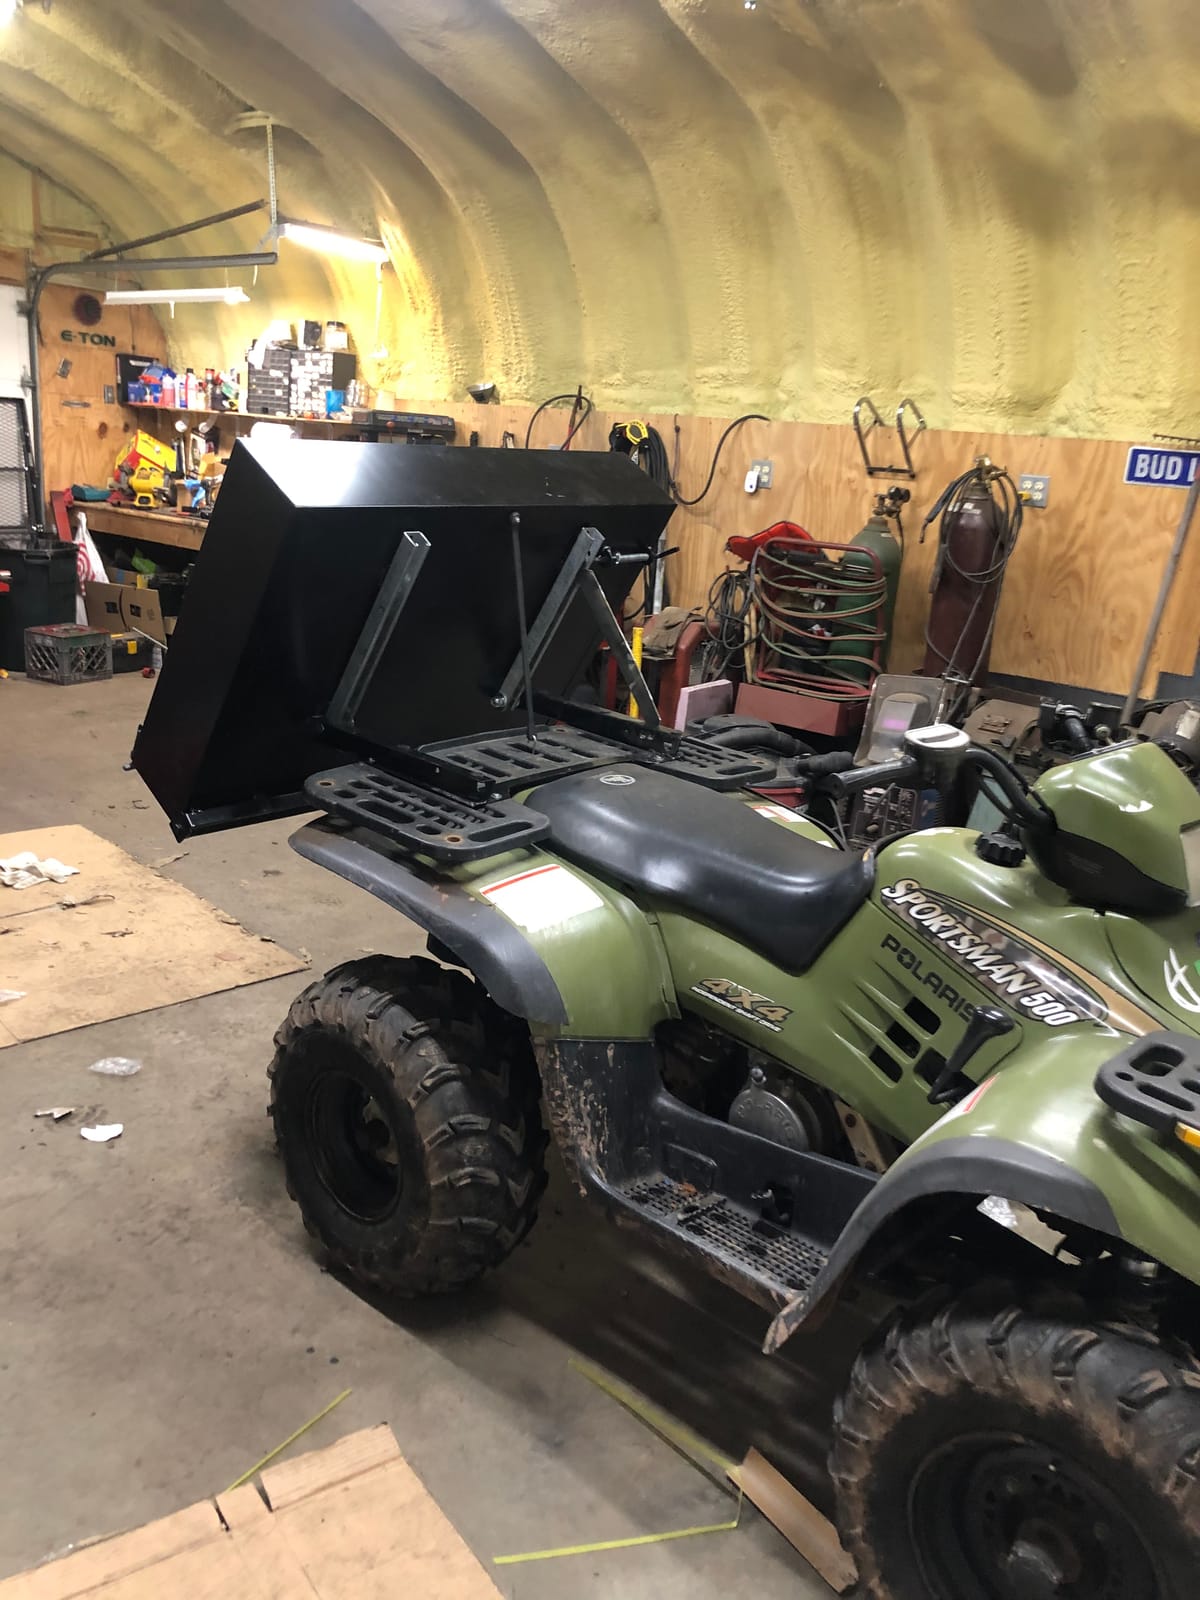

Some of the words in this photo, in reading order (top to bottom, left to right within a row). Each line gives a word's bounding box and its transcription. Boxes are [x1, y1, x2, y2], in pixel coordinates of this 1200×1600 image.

[1134, 453, 1182, 481] BUD
[881, 878, 1039, 994] SPORTSMAN
[1019, 992, 1079, 1026] 500
[881, 933, 977, 1023] POLARIS
